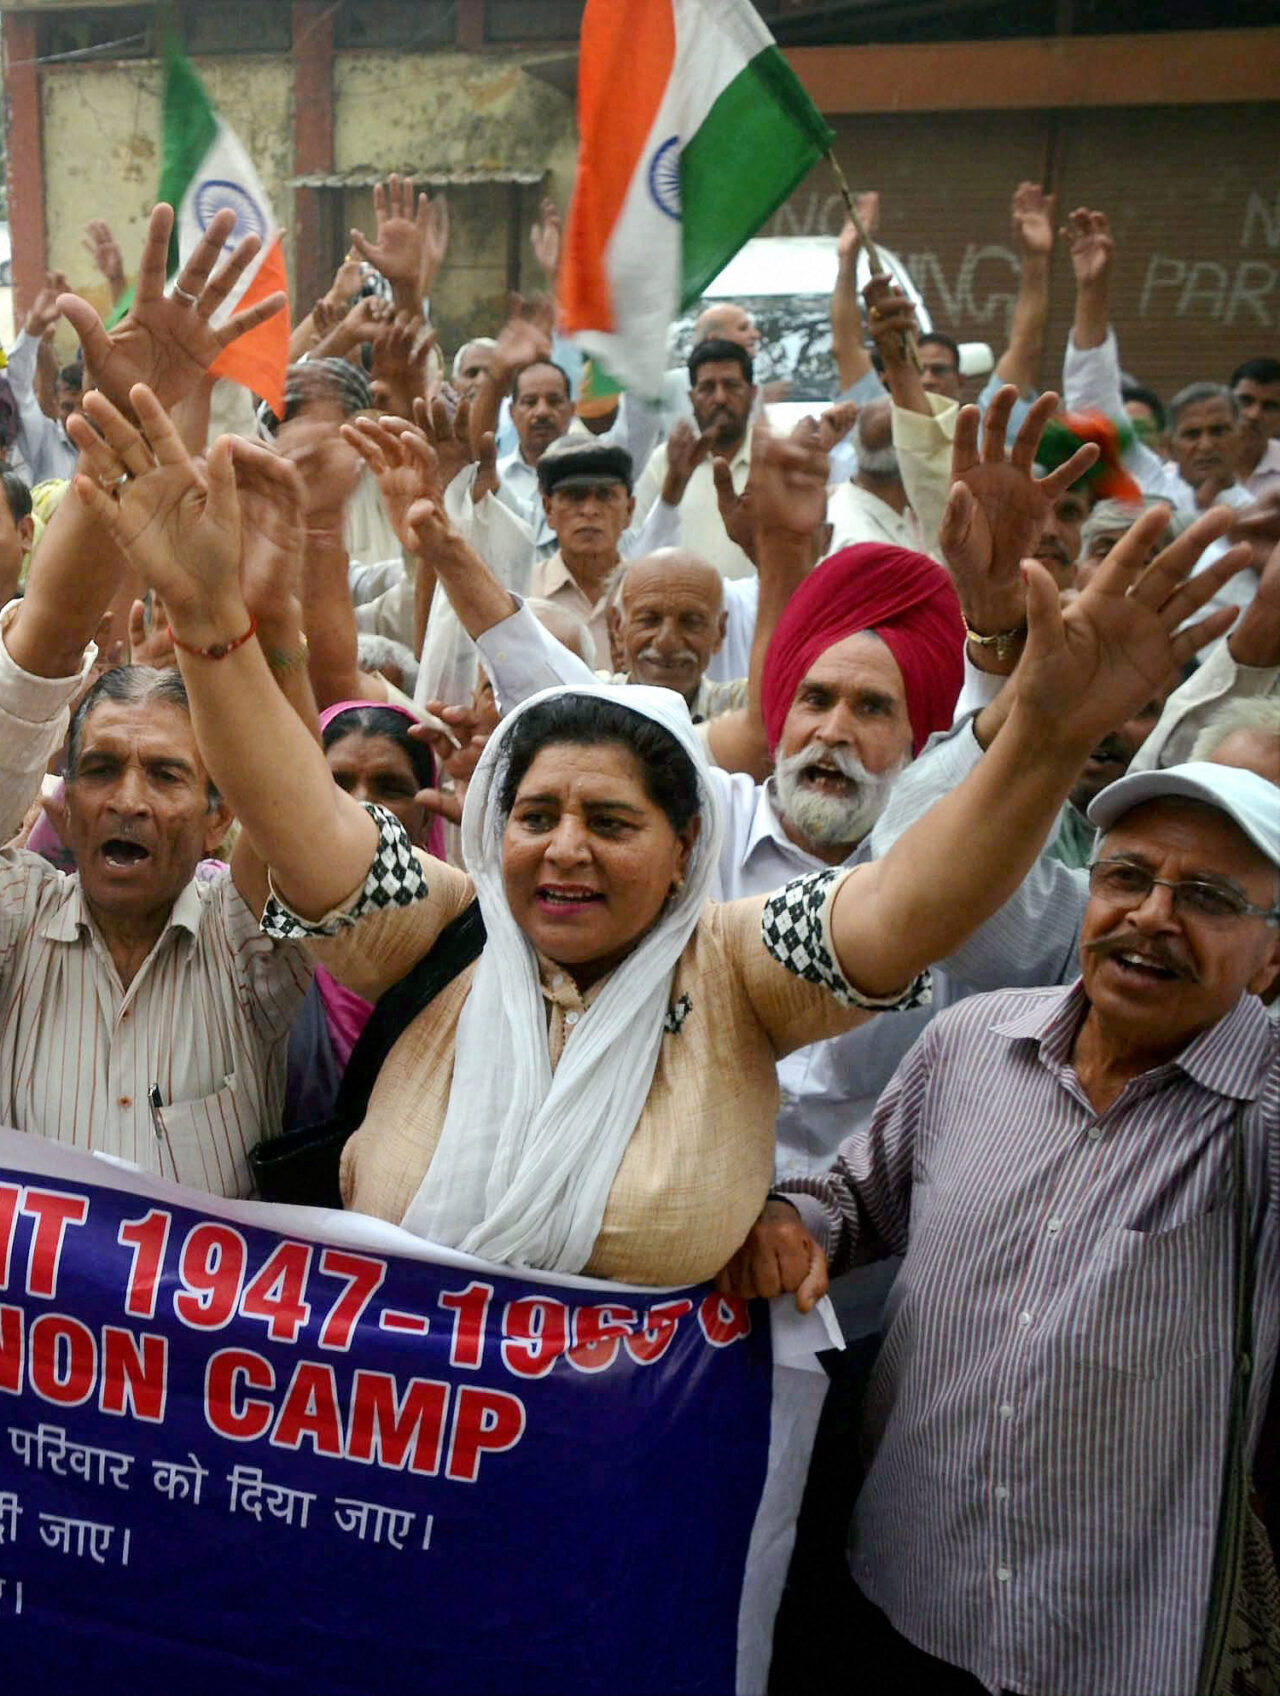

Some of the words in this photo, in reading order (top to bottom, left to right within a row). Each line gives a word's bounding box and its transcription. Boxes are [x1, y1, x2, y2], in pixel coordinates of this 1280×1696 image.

[204, 1347, 526, 1483] CAMP
[8, 1423, 134, 1489] परिवार
[152, 1453, 209, 1504] को
[227, 1465, 316, 1528] दिया
